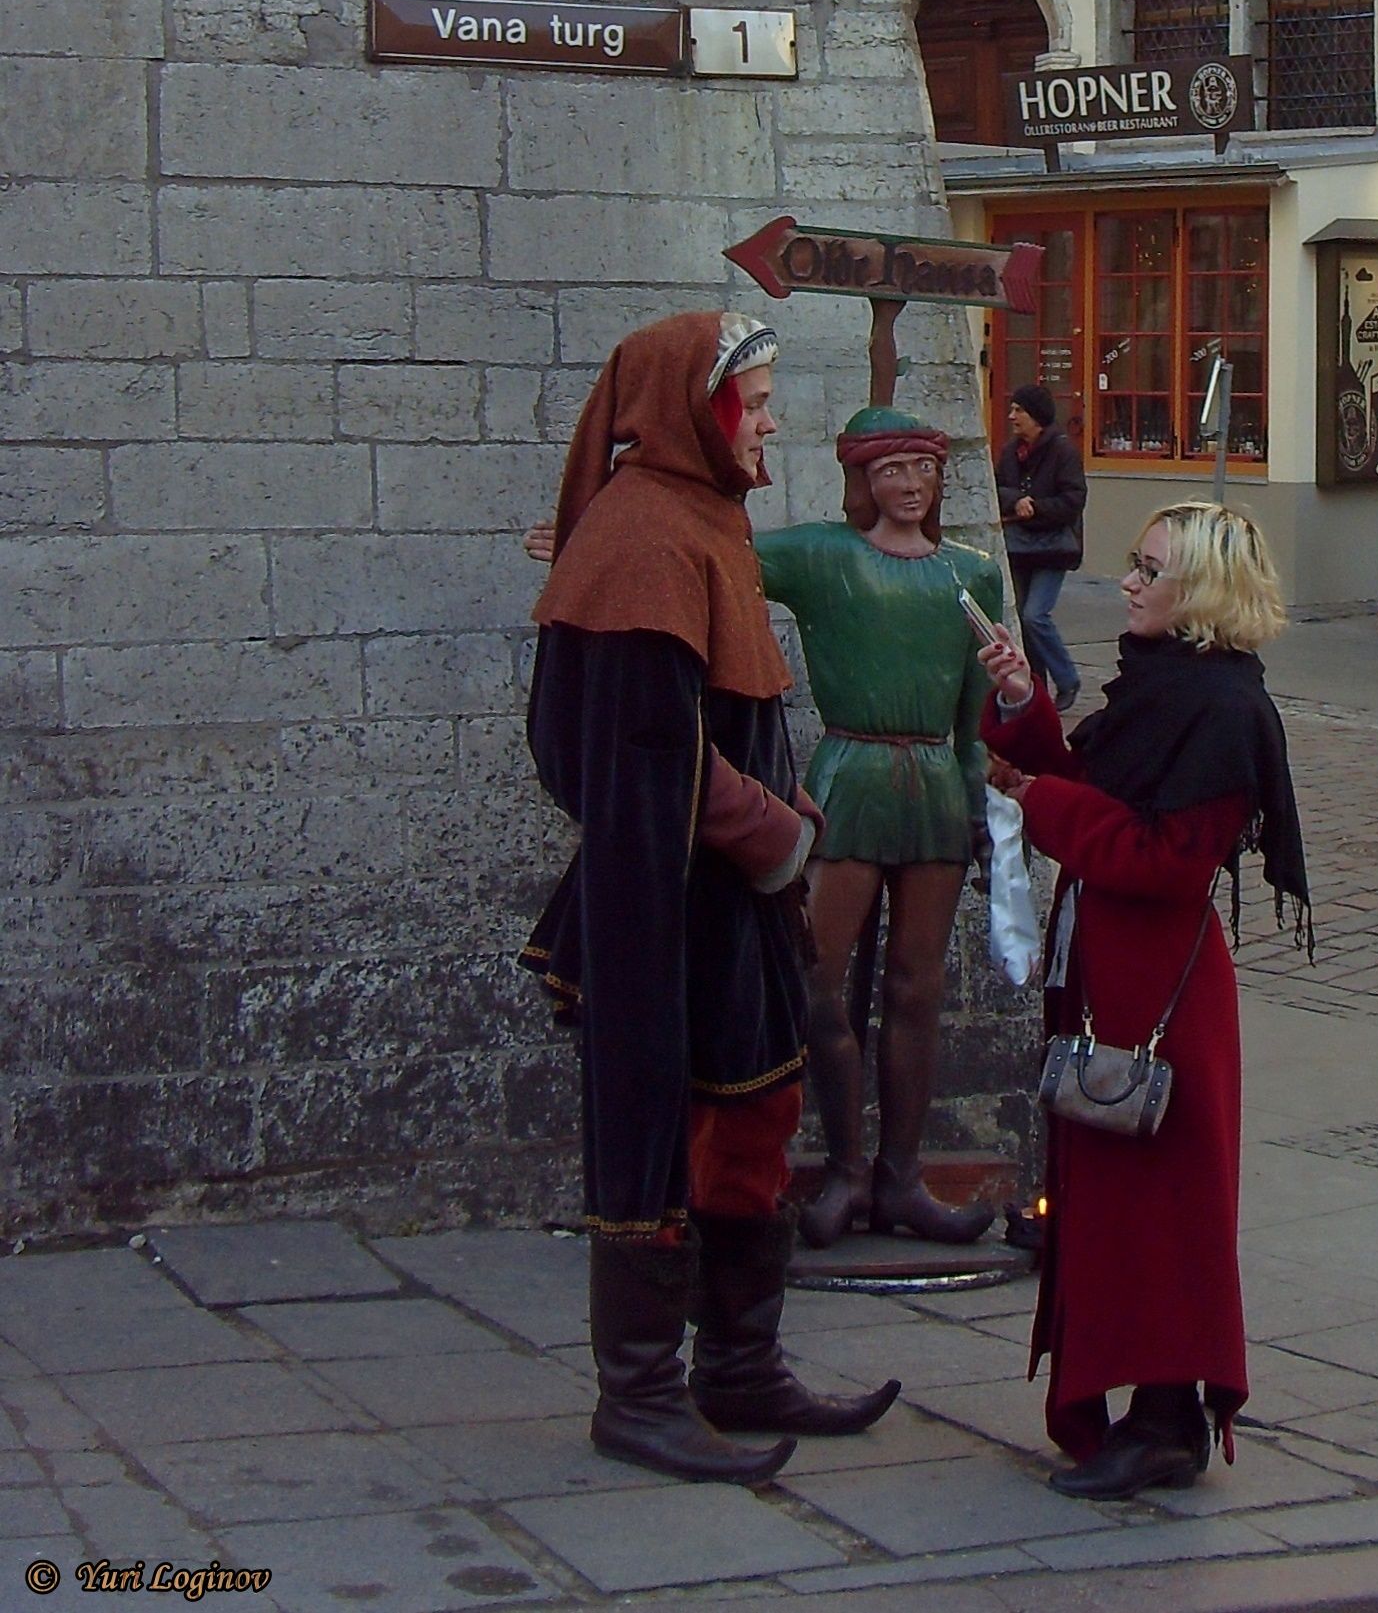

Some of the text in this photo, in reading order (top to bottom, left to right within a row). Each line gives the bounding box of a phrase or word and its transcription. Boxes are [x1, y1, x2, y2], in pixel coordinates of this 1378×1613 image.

[431, 7, 749, 65] Vana turg 1
[1018, 70, 1177, 121] HOPNER
[1097, 120, 1118, 131] BEER
[1119, 116, 1179, 130] RESTAURANT
